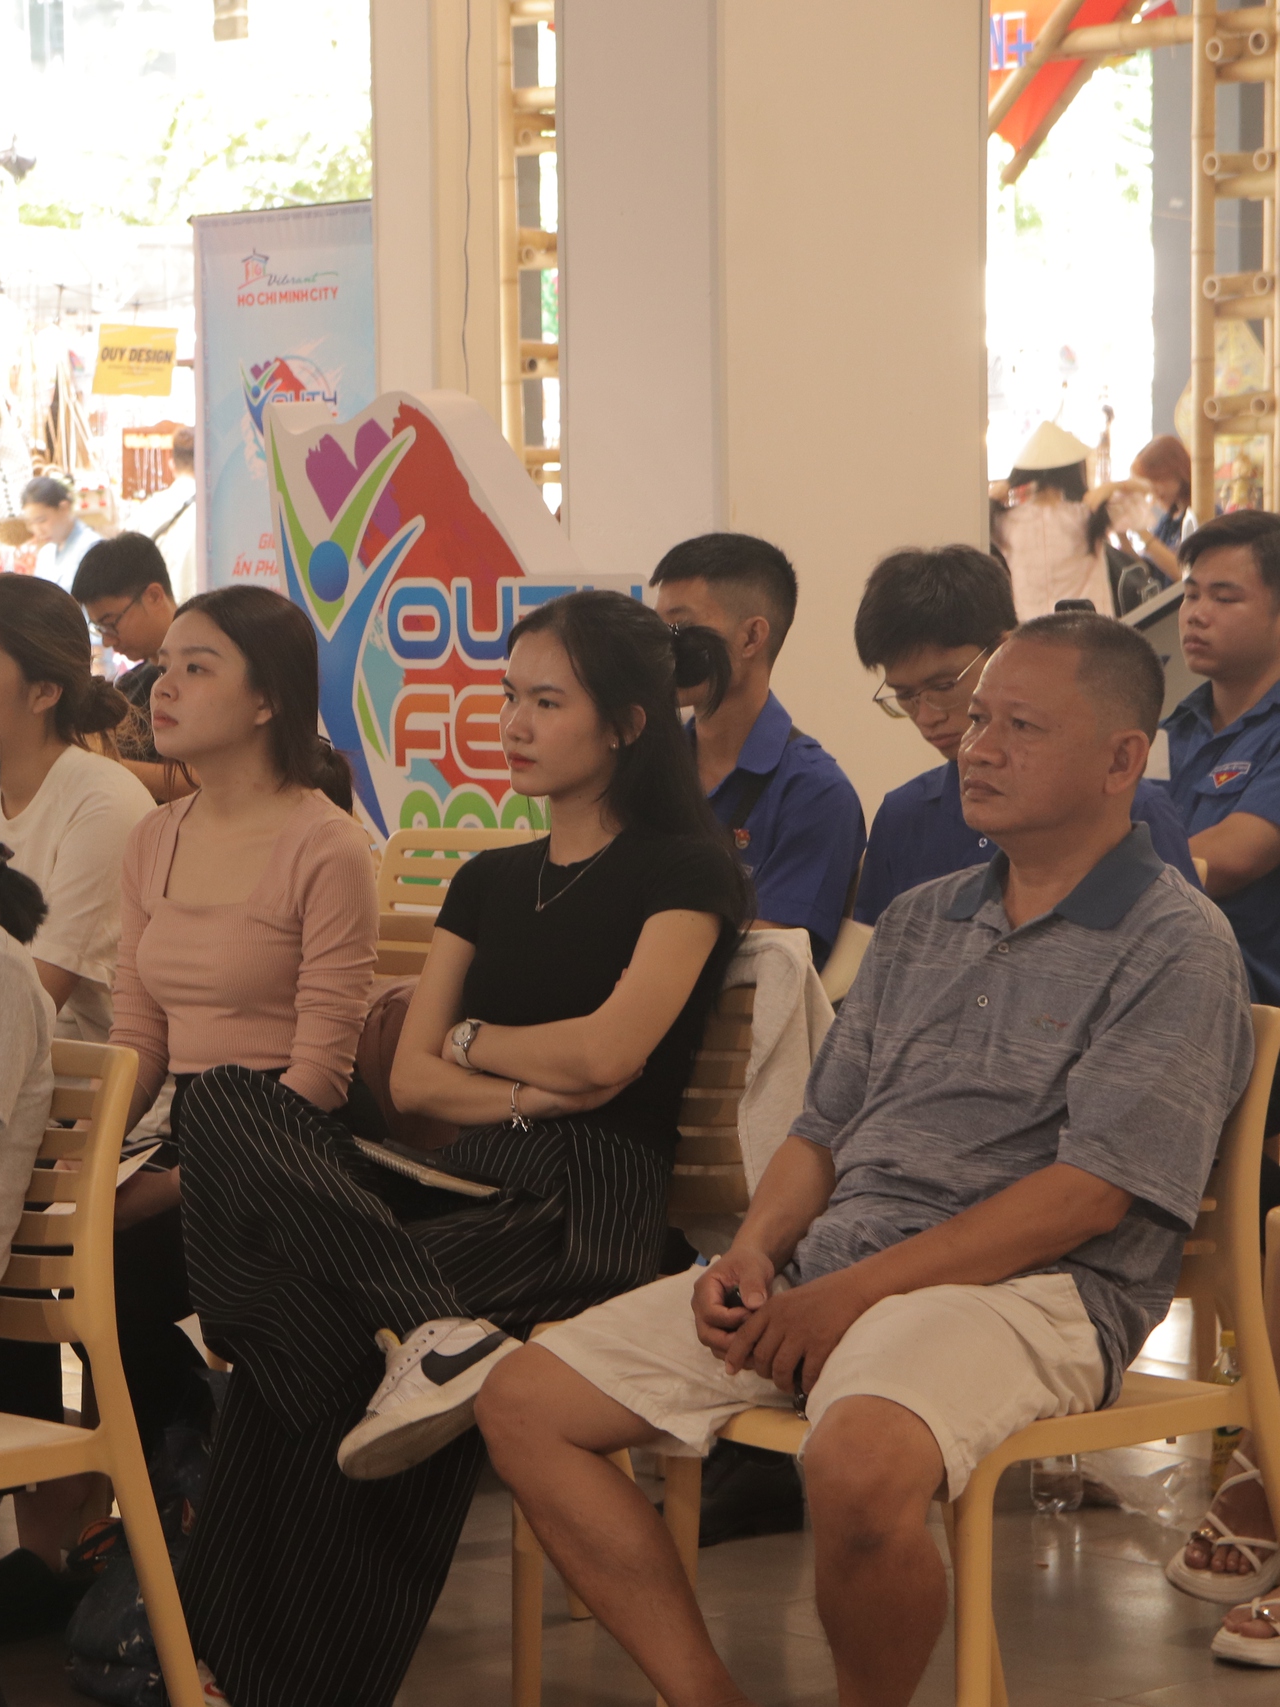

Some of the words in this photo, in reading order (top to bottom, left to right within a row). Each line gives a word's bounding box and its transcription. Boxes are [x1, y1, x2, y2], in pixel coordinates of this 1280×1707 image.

[237, 293, 255, 307] HO
[257, 291, 277, 306] CHI
[279, 289, 309, 304] MINH
[309, 286, 339, 302] CITY
[129, 348, 173, 364] DESIGN
